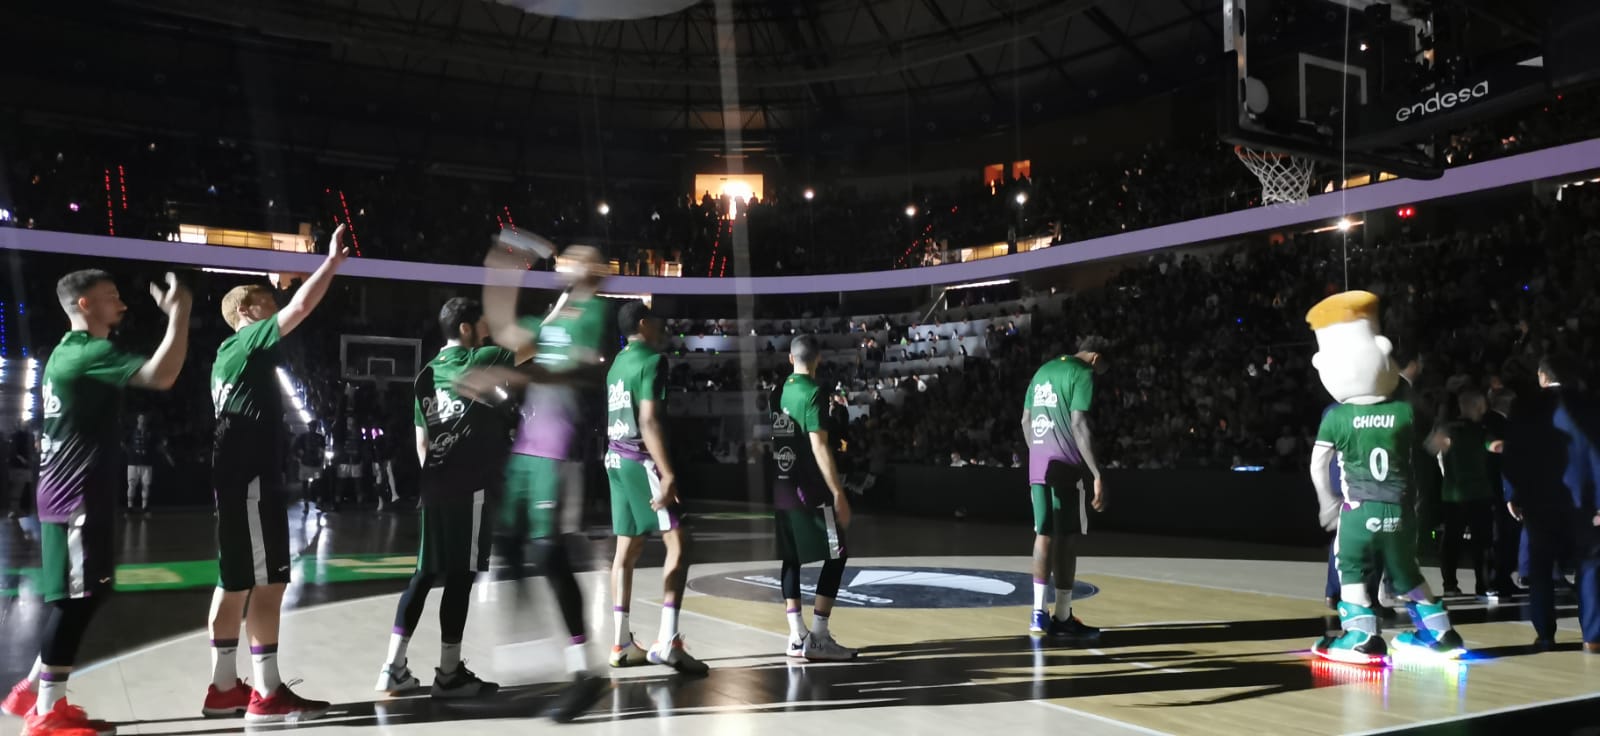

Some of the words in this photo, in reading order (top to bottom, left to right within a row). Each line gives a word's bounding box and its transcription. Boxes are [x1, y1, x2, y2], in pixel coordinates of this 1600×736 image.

[1396, 80, 1489, 122] endesa
[1353, 414, 1395, 428] CHICUI
[1369, 447, 1389, 482] 0
